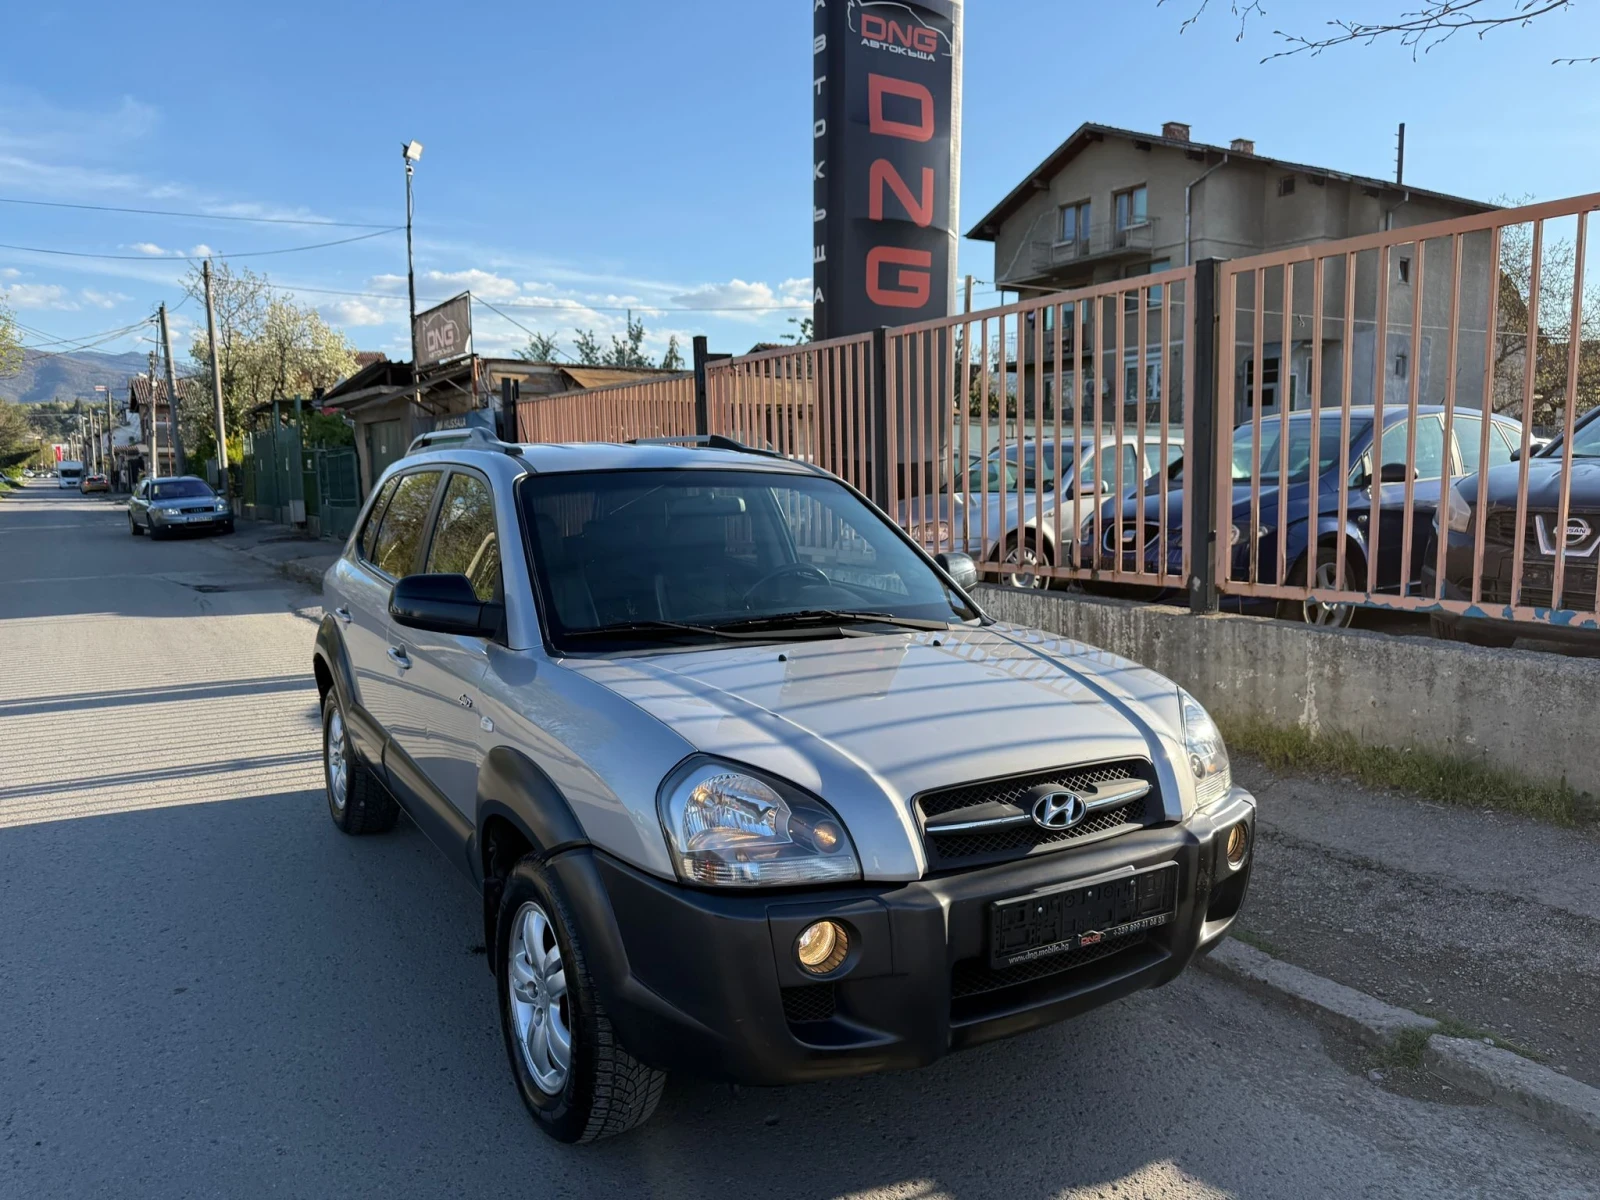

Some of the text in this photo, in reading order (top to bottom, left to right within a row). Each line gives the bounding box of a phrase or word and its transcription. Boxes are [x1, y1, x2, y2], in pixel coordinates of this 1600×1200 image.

[861, 13, 937, 53] DNG
[866, 72, 935, 309] DNG
[427, 323, 454, 352] DNG
